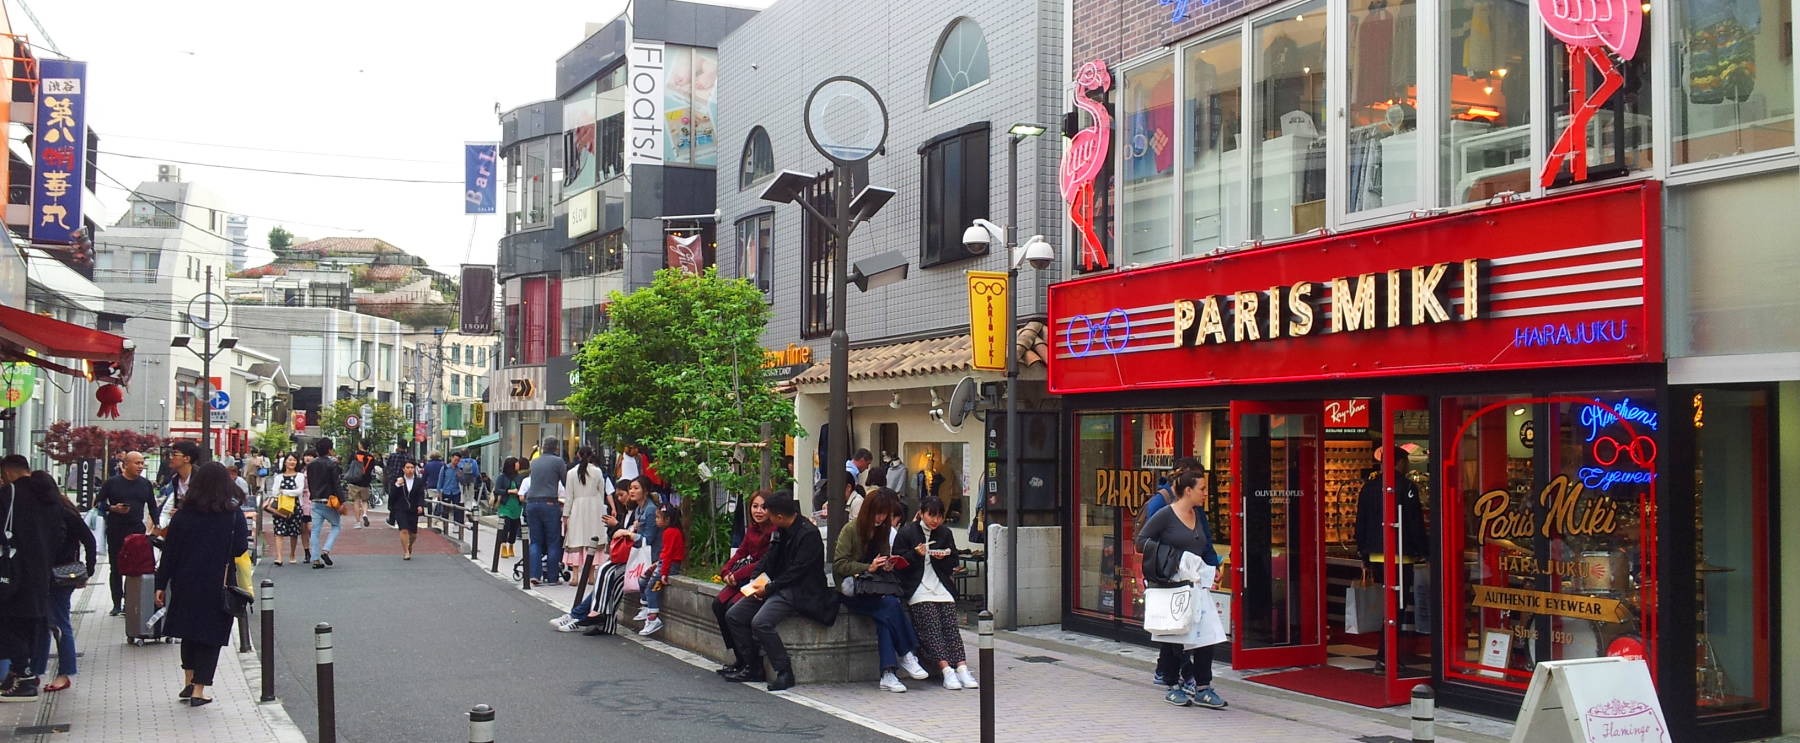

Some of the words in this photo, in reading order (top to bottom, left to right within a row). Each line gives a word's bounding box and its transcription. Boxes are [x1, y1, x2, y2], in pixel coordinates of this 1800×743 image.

[633, 46, 662, 161] Floats!
[1174, 281, 1313, 348] PARIS
[1331, 258, 1478, 334] MIKI
[1514, 320, 1628, 347] HARAJUKU
[1325, 399, 1366, 424] Ray-Ban
[1096, 469, 1152, 516] PARIS
[1473, 489, 1535, 546] Paris
[1540, 475, 1618, 538] Miki
[1498, 556, 1591, 578] HARAJUKU
[1484, 590, 1541, 608] AUTHENTIC
[1545, 596, 1602, 615] EYEWEAR
[1602, 721, 1651, 743] Flamingo
